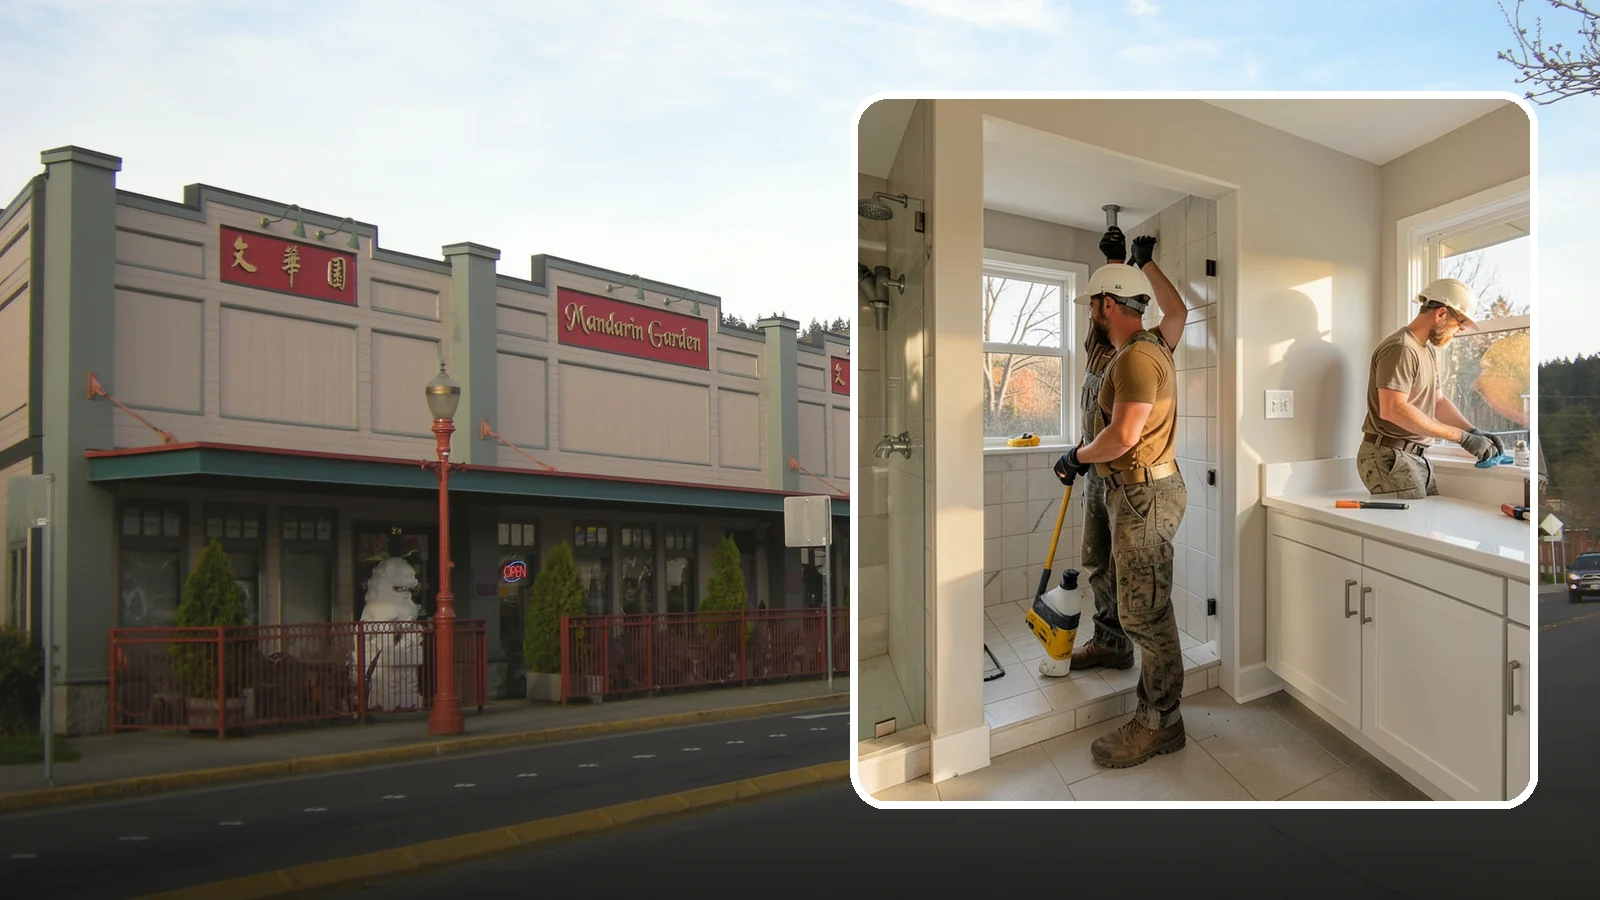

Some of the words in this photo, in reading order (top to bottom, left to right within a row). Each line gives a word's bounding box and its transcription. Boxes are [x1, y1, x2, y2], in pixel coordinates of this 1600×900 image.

[230, 235, 346, 291] 文華園
[564, 302, 644, 341] Mandarin
[647, 320, 701, 352] Garden
[834, 363, 846, 386] 文
[503, 565, 527, 578] OPEN
